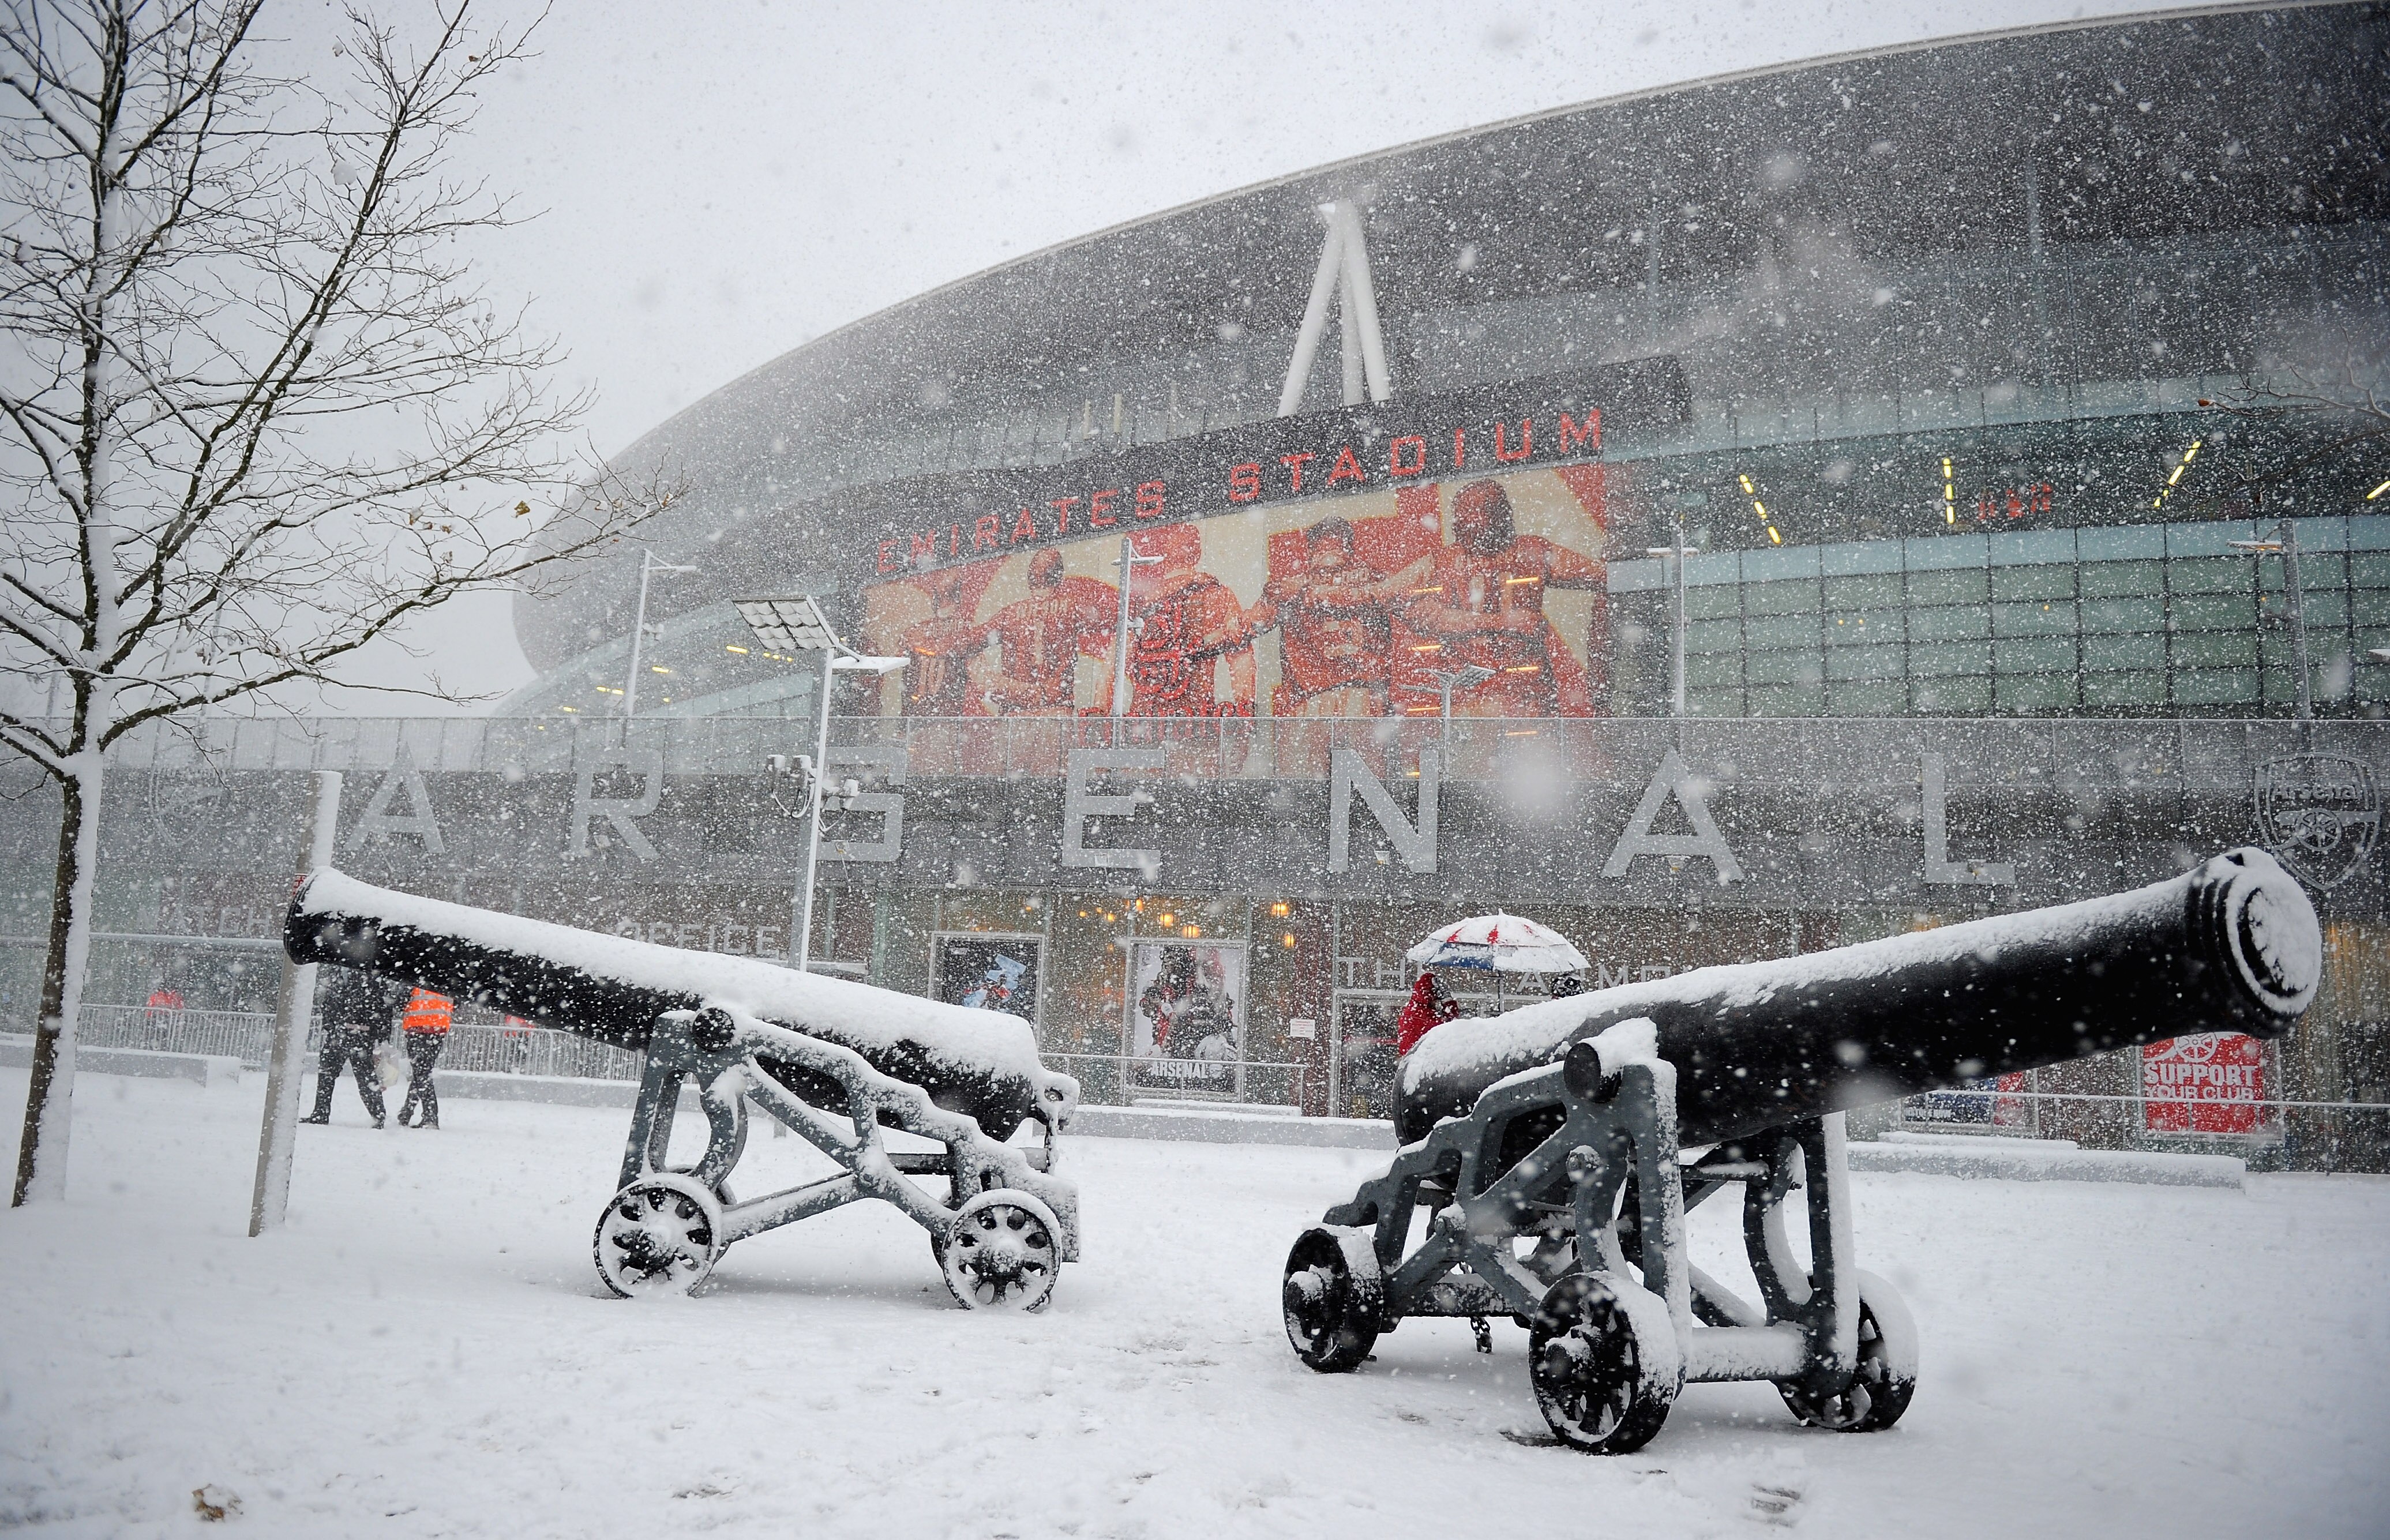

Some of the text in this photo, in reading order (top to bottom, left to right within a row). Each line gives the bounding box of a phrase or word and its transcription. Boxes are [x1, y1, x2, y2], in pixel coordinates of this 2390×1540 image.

[878, 408, 1603, 573] EMIRATES STADIUM
[2271, 783, 2363, 801] Arsenal
[346, 741, 2016, 885] ARSENAL
[1150, 1061, 1208, 1079] ARSENAL
[2144, 1063, 2256, 1086] SUPPORT
[2144, 1085, 2254, 1100] YOUR CLUB
